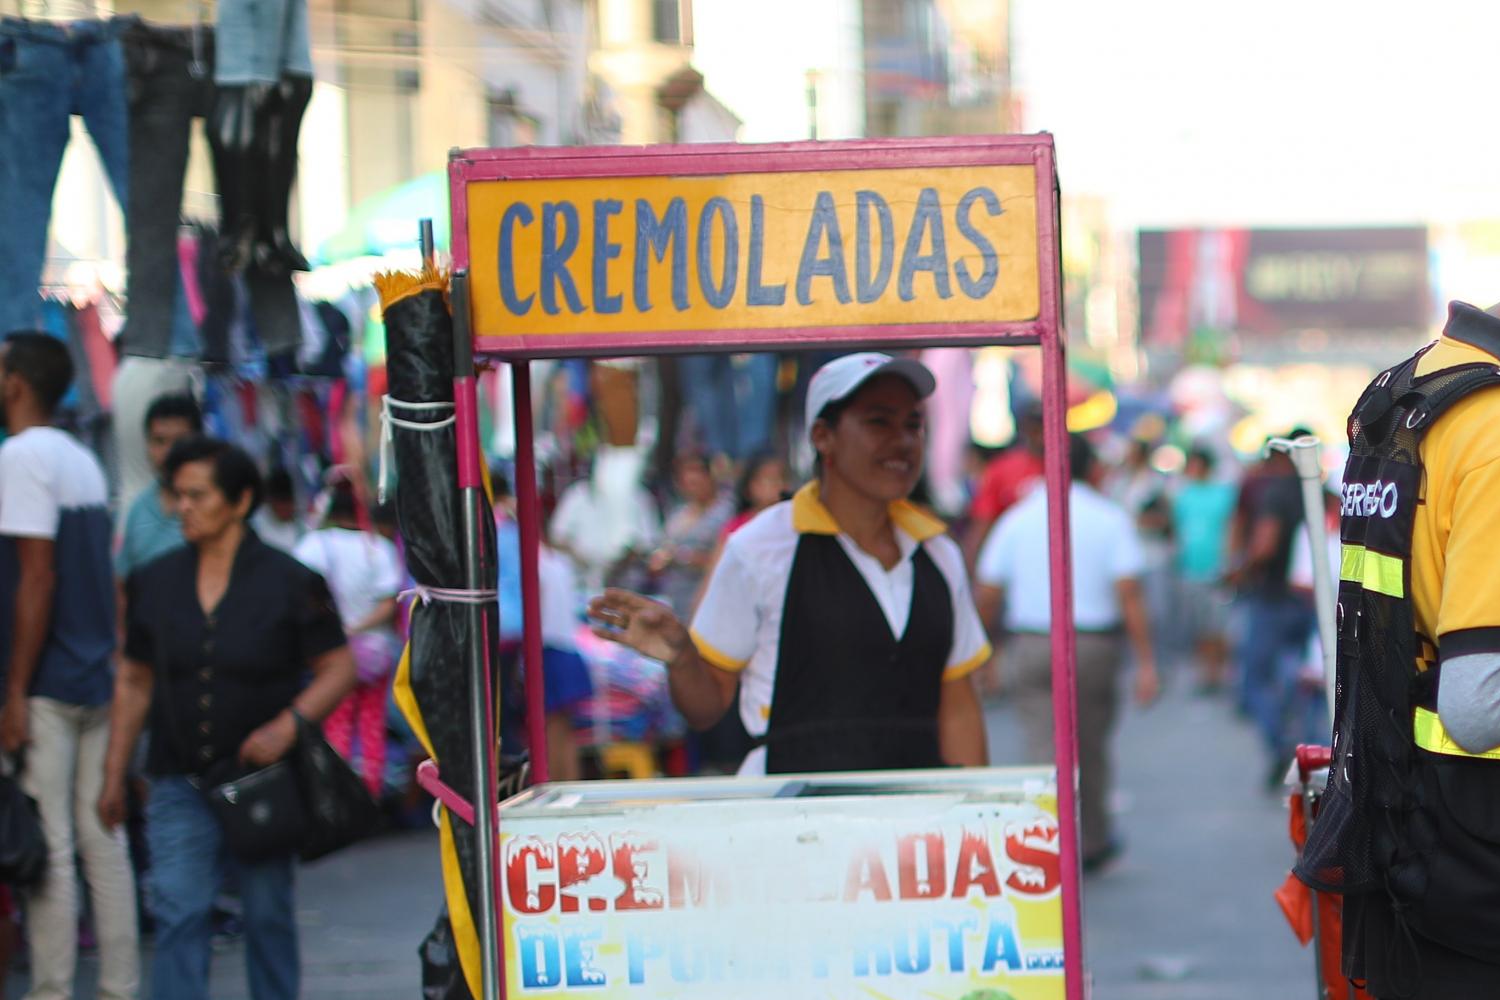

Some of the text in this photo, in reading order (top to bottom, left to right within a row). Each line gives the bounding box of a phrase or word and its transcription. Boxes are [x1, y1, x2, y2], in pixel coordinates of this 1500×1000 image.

[497, 187, 1006, 316] CREMOLADAS
[506, 819, 1062, 914] CREMADAS
[518, 922, 606, 988] DE
